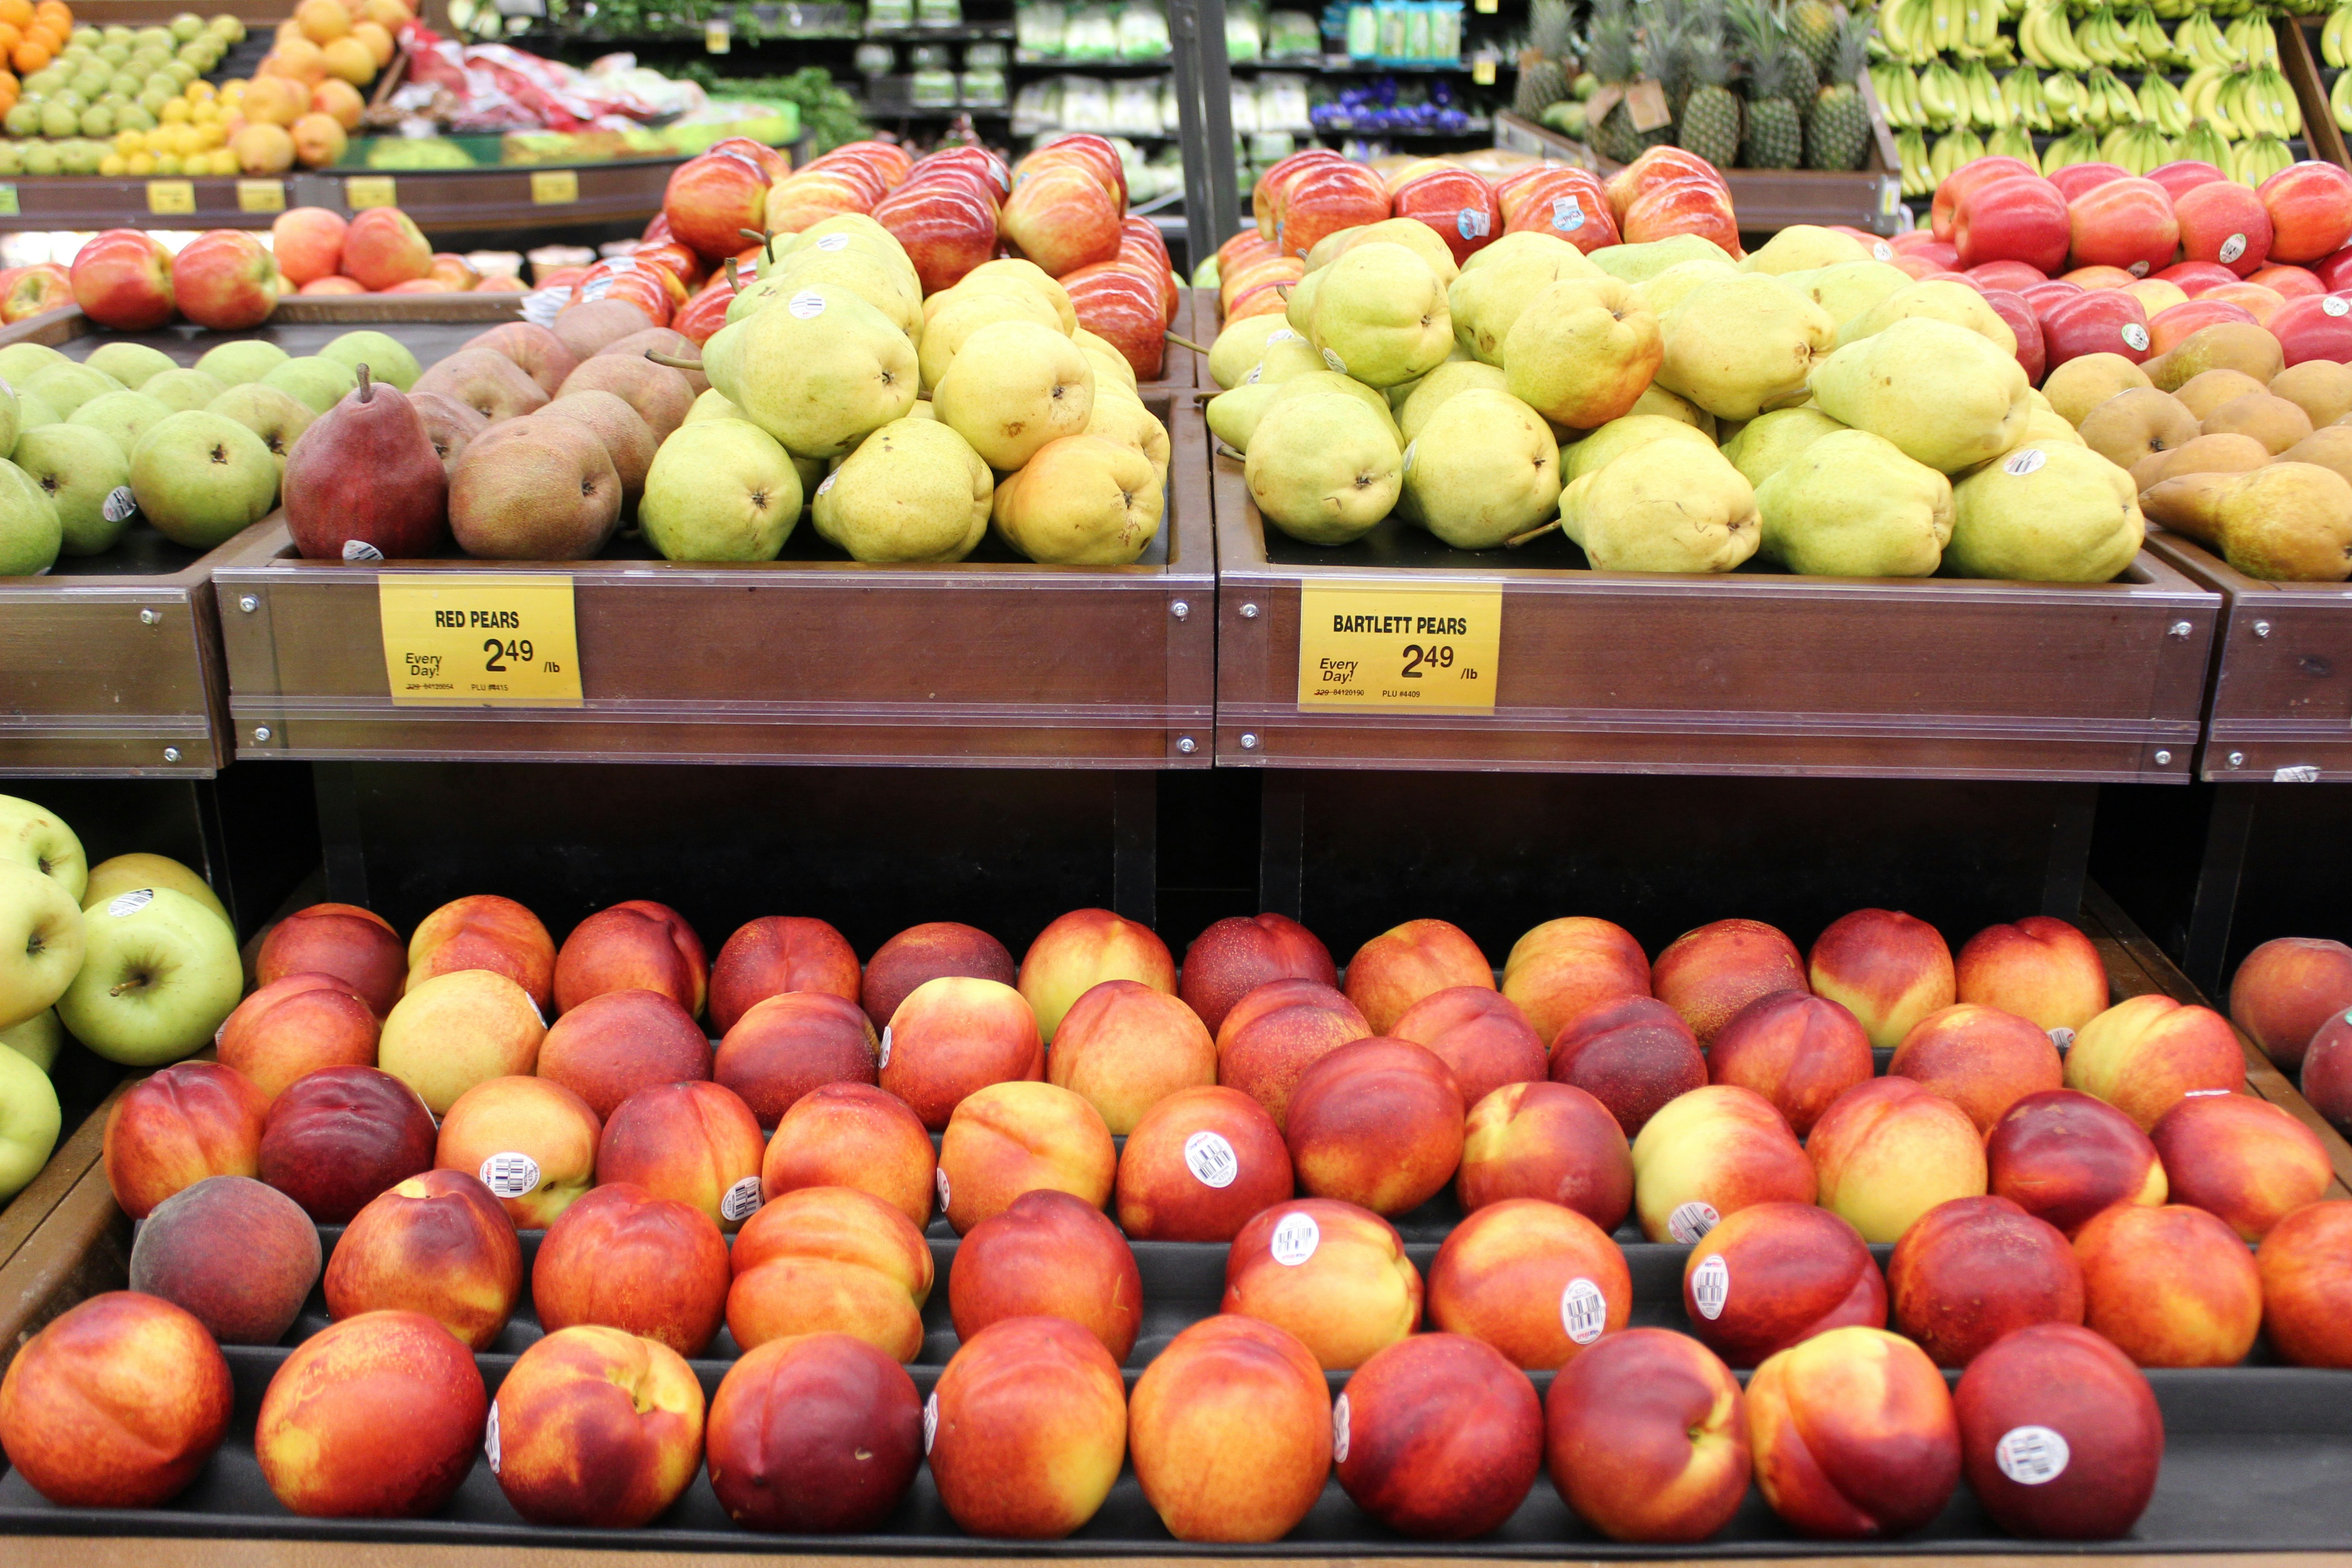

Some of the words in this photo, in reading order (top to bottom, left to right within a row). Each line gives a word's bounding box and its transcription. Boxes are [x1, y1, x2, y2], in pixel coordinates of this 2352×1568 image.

[436, 611, 465, 628] RED
[470, 611, 519, 628] PEARS
[1334, 615, 1412, 634] BARTLETT
[1417, 617, 1467, 635] PEARS
[406, 653, 442, 667] Every
[1319, 658, 1358, 673] Every
[411, 665, 440, 678] Day!
[544, 662, 560, 673] /lb
[1460, 668, 1478, 680] /lb
[1323, 671, 1354, 684] Day!
[1218, 1171, 1230, 1181] 4378
